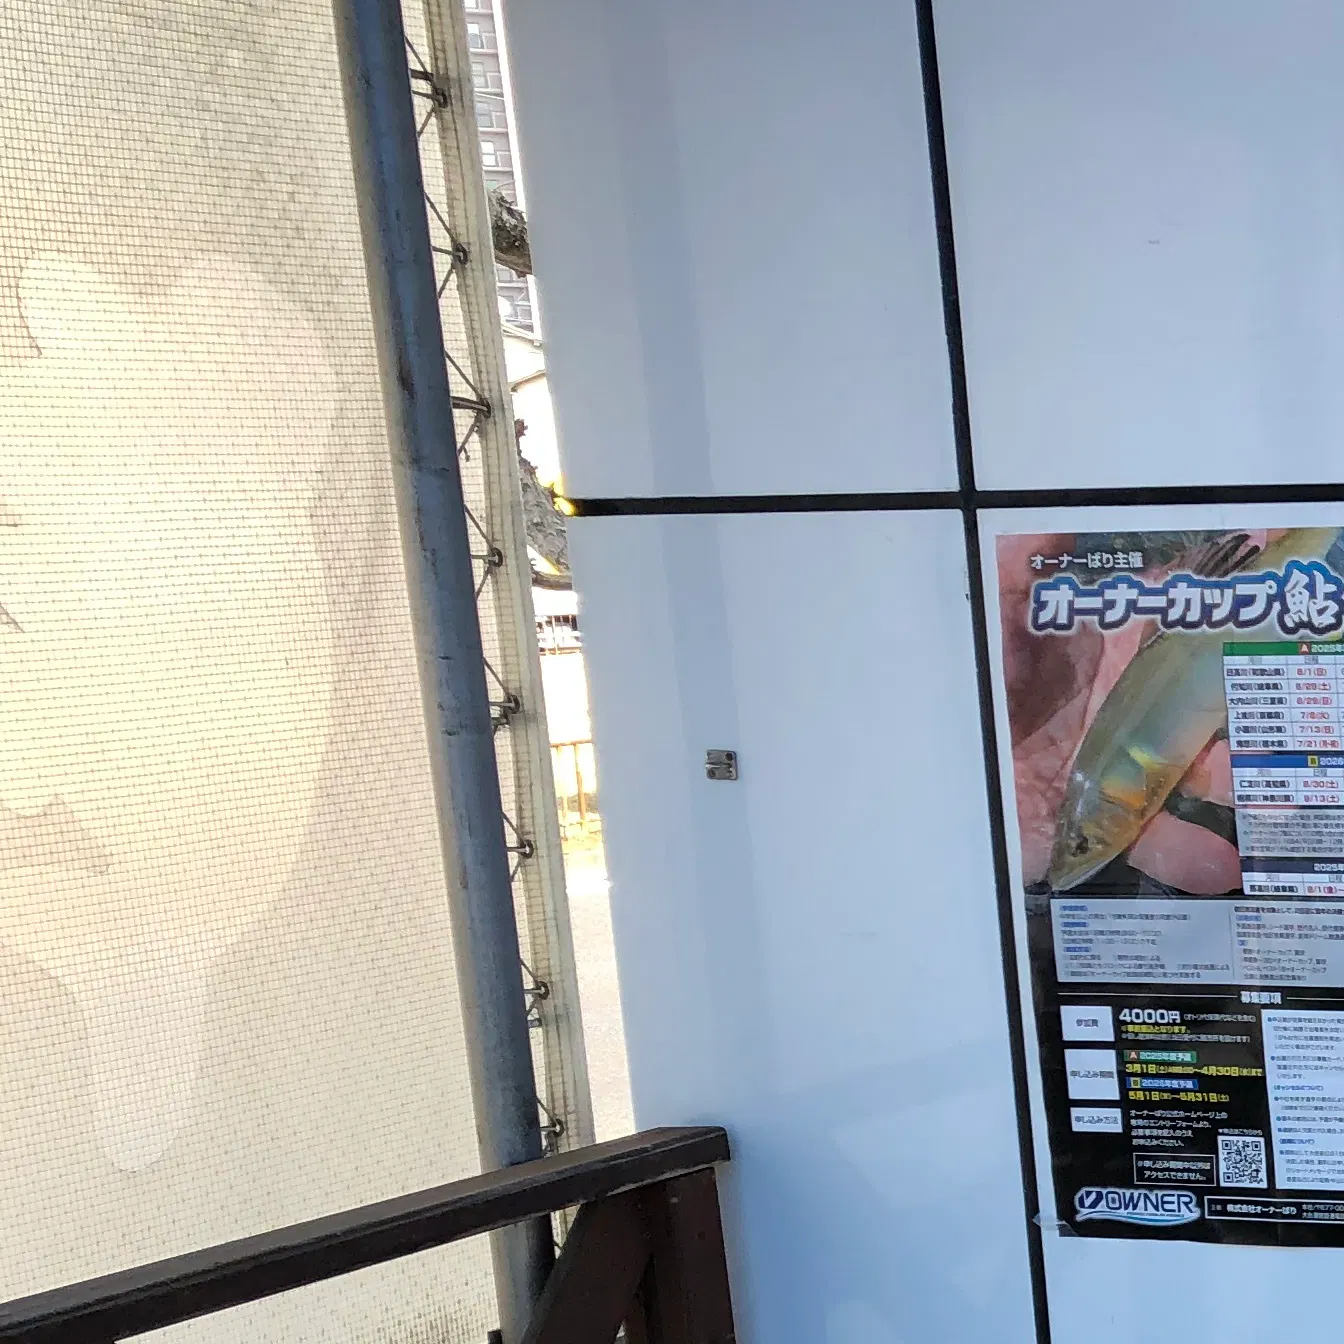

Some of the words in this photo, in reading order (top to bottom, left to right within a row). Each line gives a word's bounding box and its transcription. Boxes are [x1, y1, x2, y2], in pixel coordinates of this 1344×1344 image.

[1030, 552, 1143, 569] オーナーばり主催
[1036, 567, 1341, 630] オーナーカップ鮎
[1119, 1008, 1180, 1023] 4000円
[1106, 1191, 1194, 1213] OWNER
